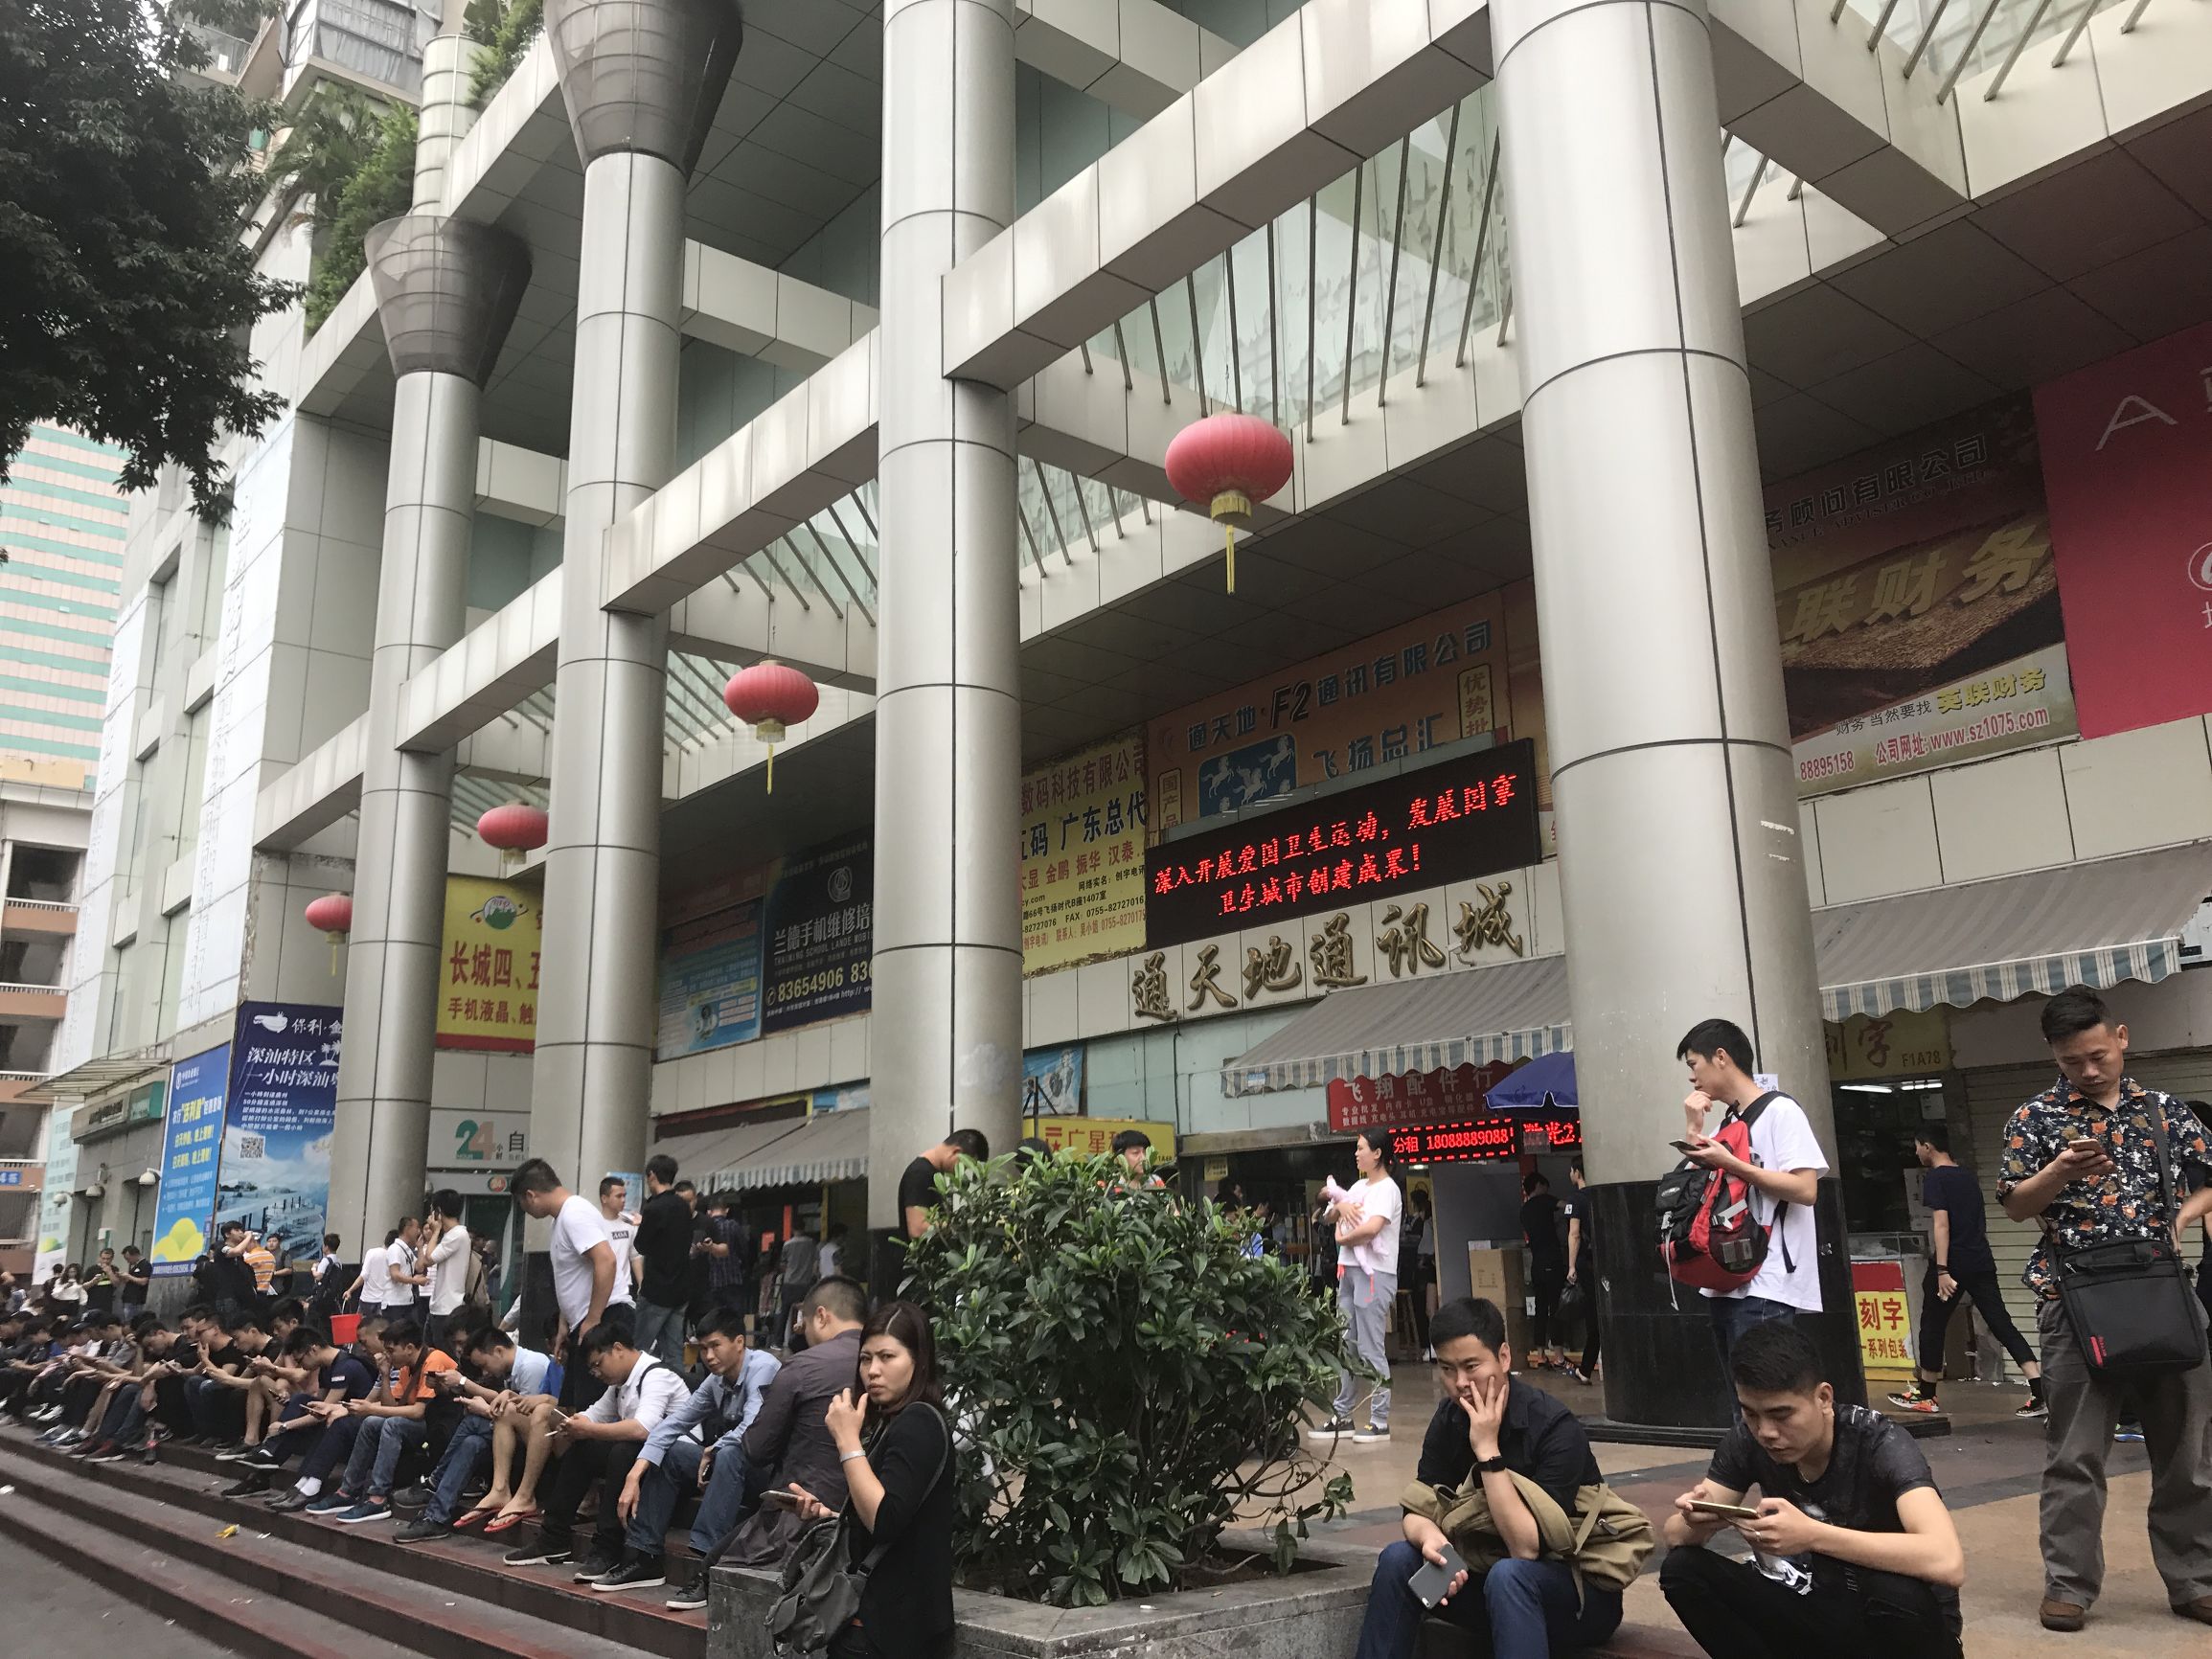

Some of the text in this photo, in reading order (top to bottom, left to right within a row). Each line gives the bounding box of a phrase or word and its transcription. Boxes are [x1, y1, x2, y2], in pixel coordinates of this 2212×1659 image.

[1776, 524, 2051, 644] 联财务
[1800, 750, 1855, 781] 88895158
[1930, 707, 2049, 752] www.sz1075.com
[1086, 896, 1144, 919] 0755-82727016
[1131, 880, 1523, 1022] 通天地通讯城
[778, 966, 844, 1003] 83654906
[247, 1046, 316, 1066] 深汕特区
[1344, 1067, 1494, 1102] 飞翔配件行
[455, 1119, 494, 1161] 24
[1394, 1128, 1508, 1153] 分租 18088889088
[1859, 1297, 1904, 1330] 刻字
